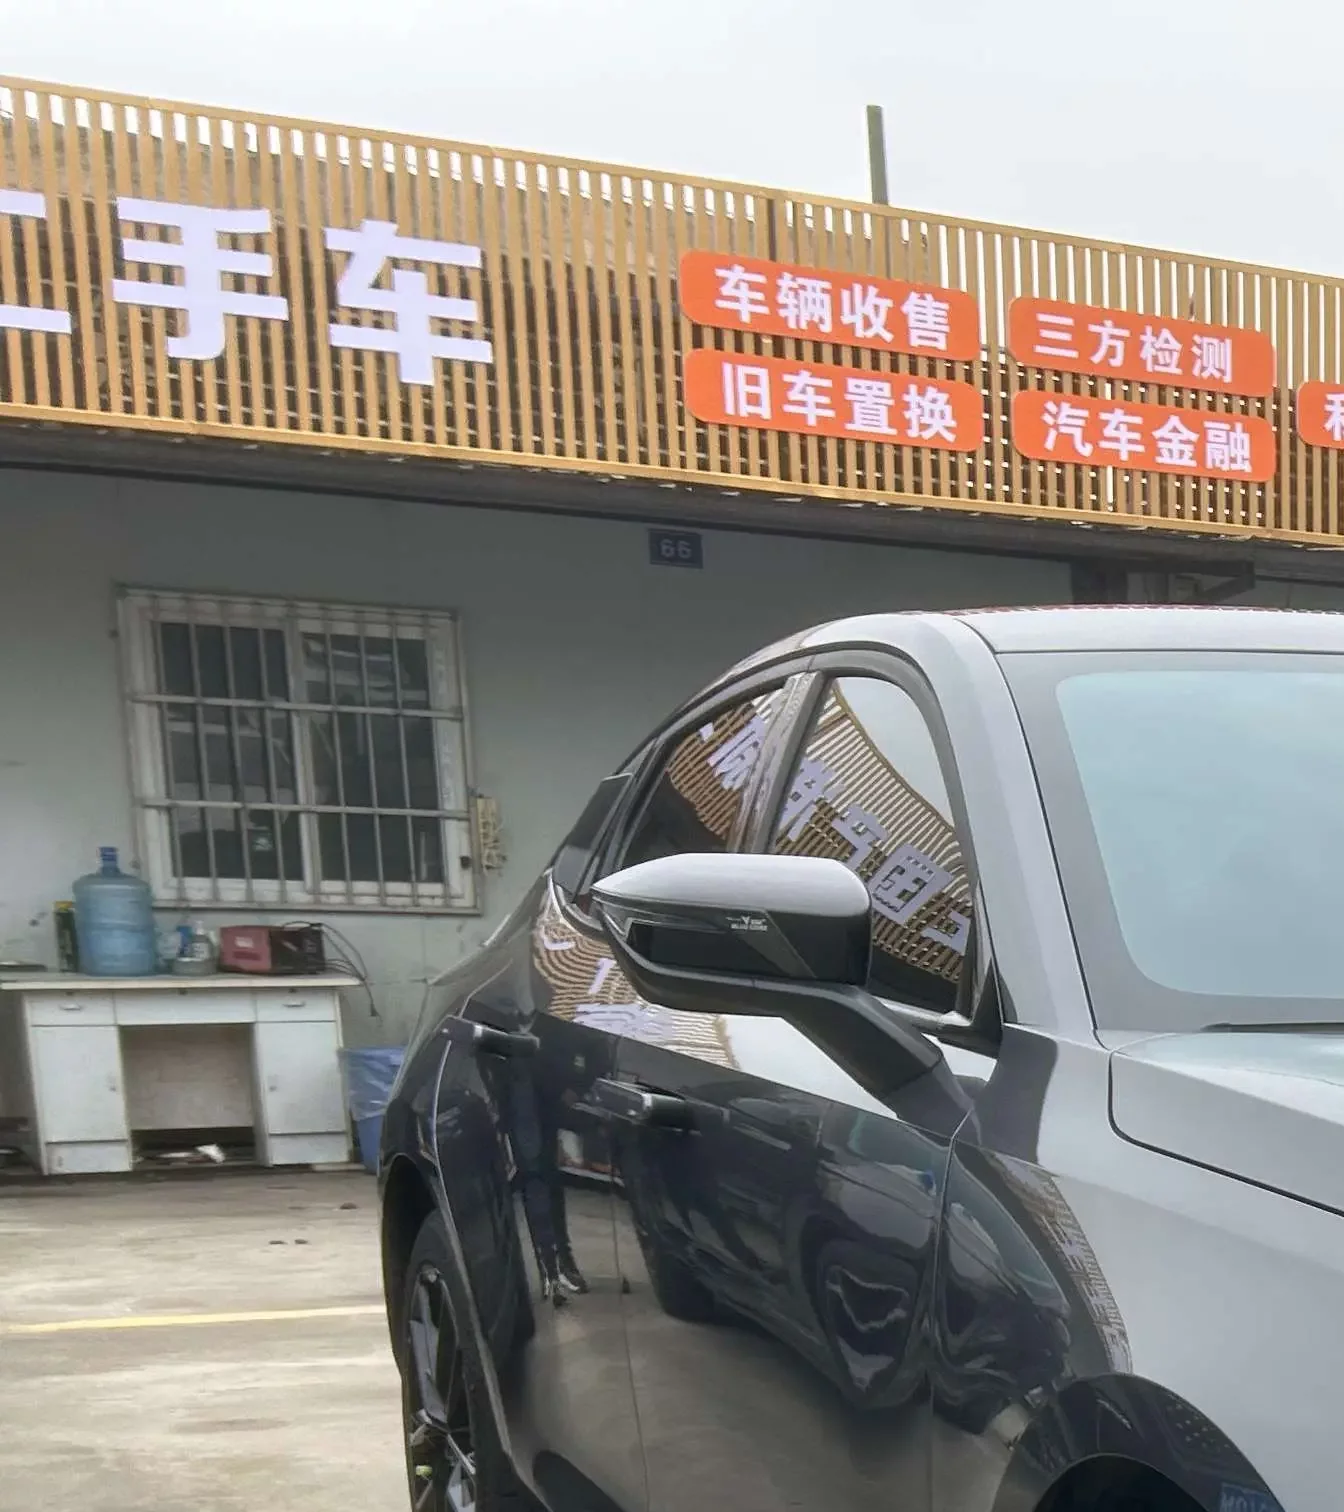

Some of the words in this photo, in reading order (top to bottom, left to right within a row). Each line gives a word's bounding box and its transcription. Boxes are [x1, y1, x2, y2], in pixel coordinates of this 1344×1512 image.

[713, 263, 951, 352] 车辆收售
[1034, 312, 1233, 384] 三方检测
[721, 361, 958, 443] 旧车置换
[1041, 400, 1253, 474] 汽车金融
